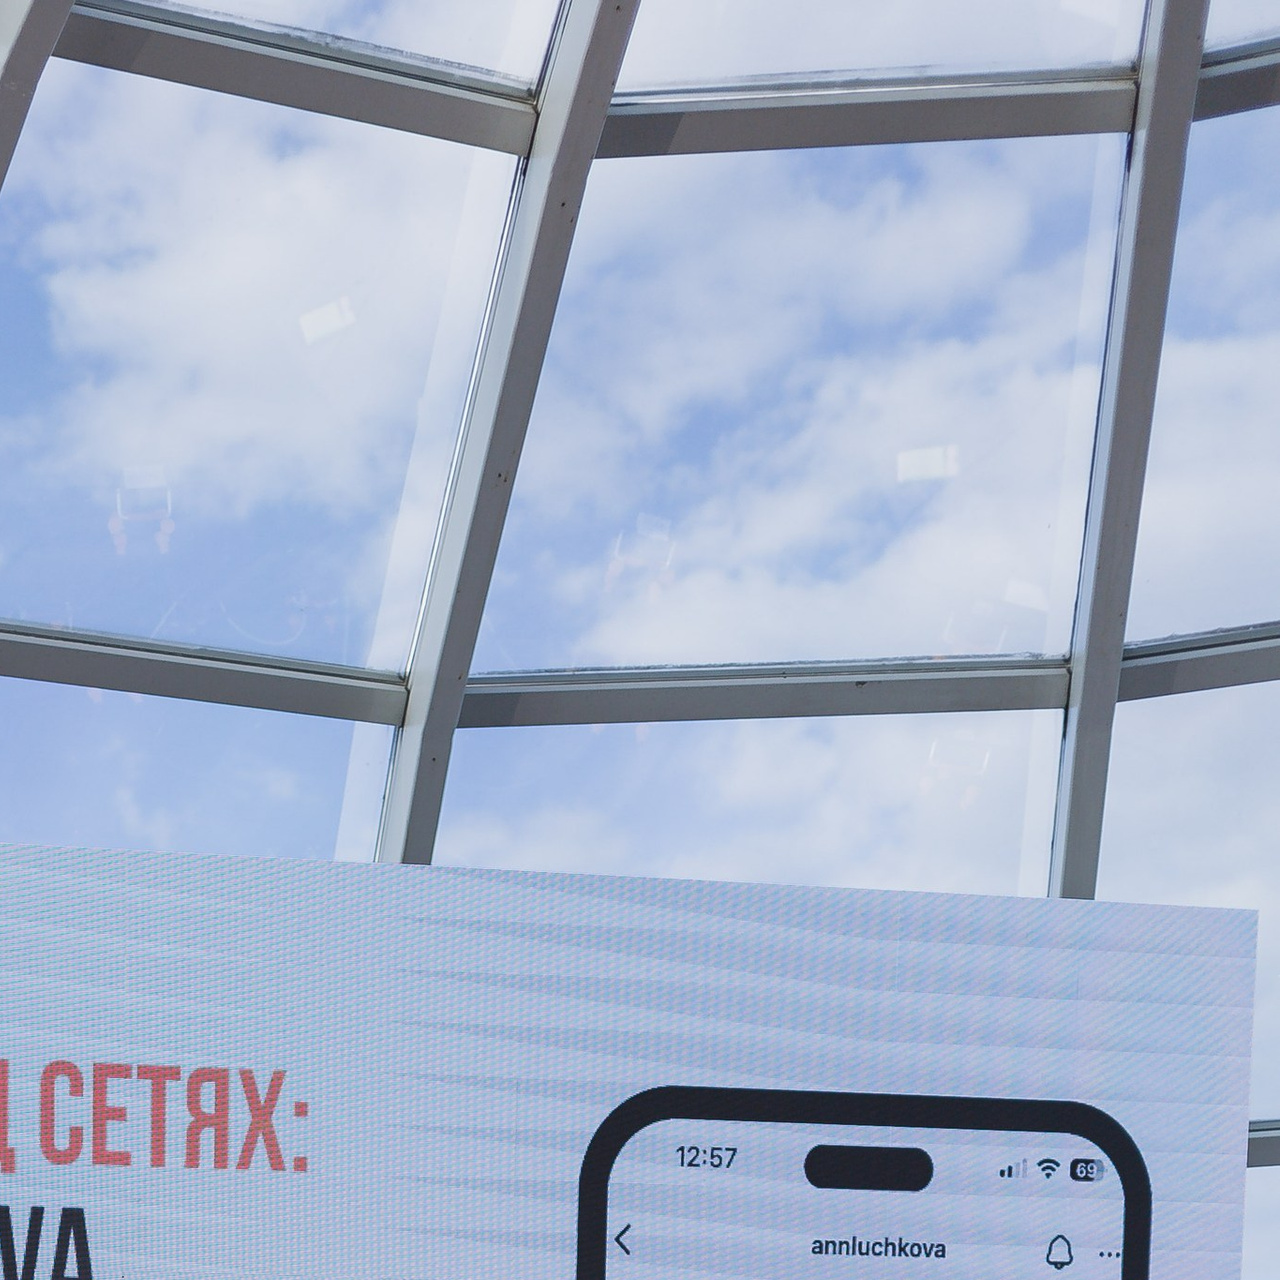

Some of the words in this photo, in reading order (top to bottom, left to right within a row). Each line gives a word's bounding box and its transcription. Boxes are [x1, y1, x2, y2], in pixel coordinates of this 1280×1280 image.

[40, 1059, 310, 1174] СЕТЯХ:
[676, 1146, 737, 1169] 12:57
[1076, 1162, 1097, 1178] 69
[810, 1237, 946, 1259] annluchkova
